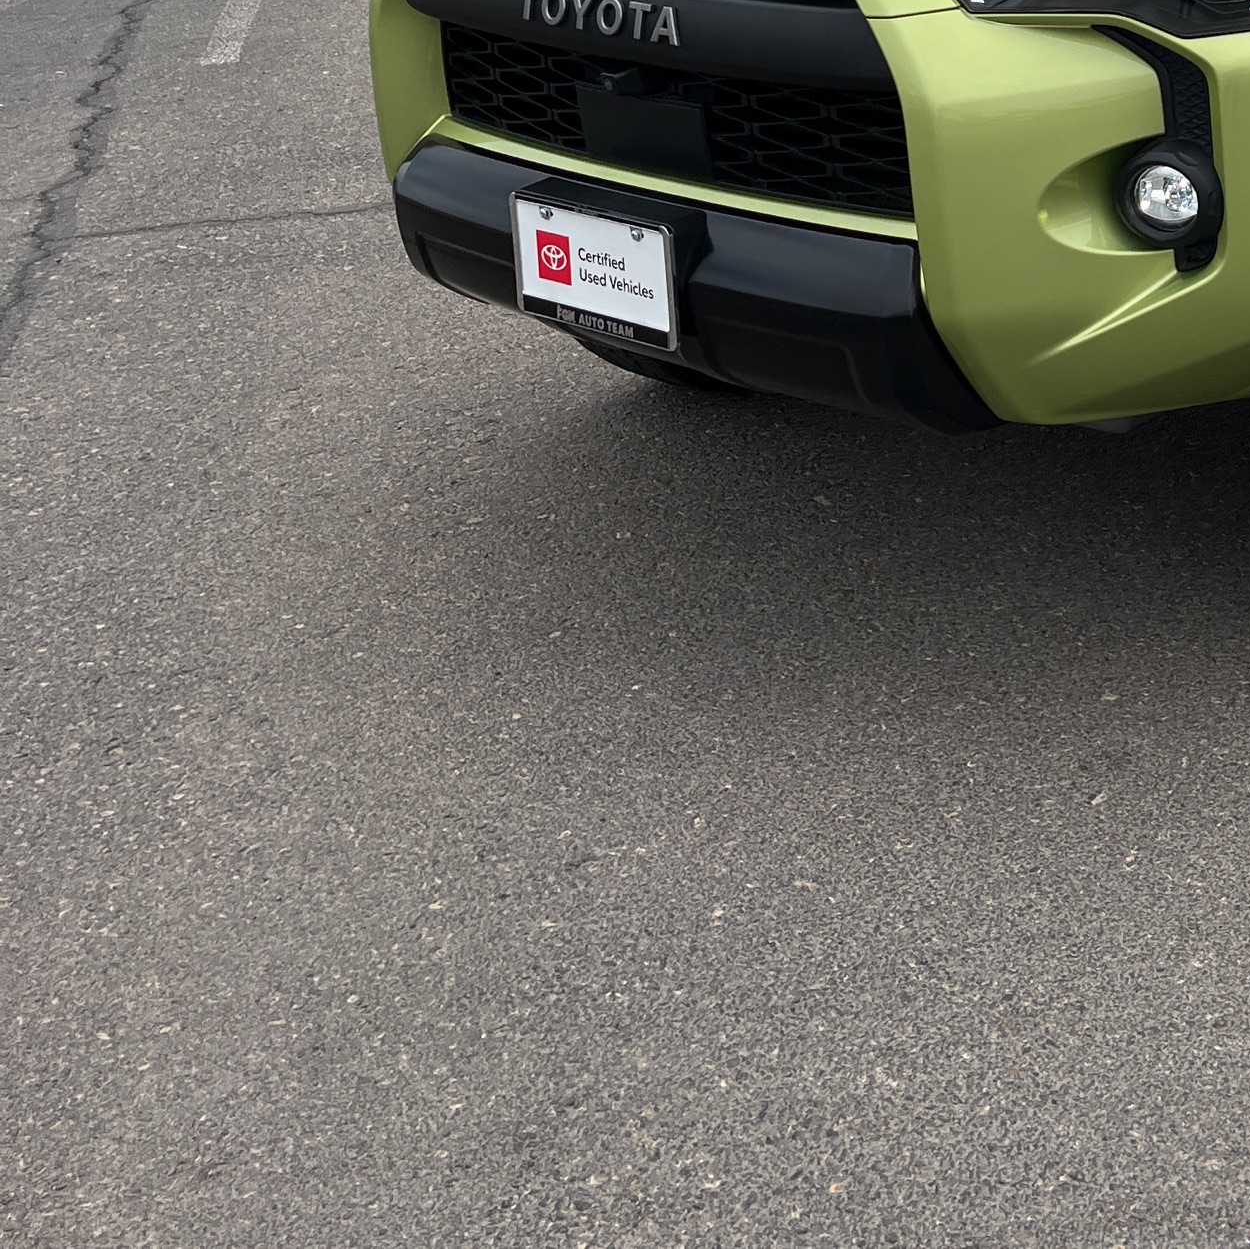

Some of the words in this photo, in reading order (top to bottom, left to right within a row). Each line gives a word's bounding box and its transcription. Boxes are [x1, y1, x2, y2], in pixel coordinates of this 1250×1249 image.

[578, 247, 625, 271] Certified
[579, 267, 607, 287] Used
[609, 275, 654, 299] Vehicles
[578, 313, 605, 331] AUTO
[606, 320, 635, 339] TEAM
